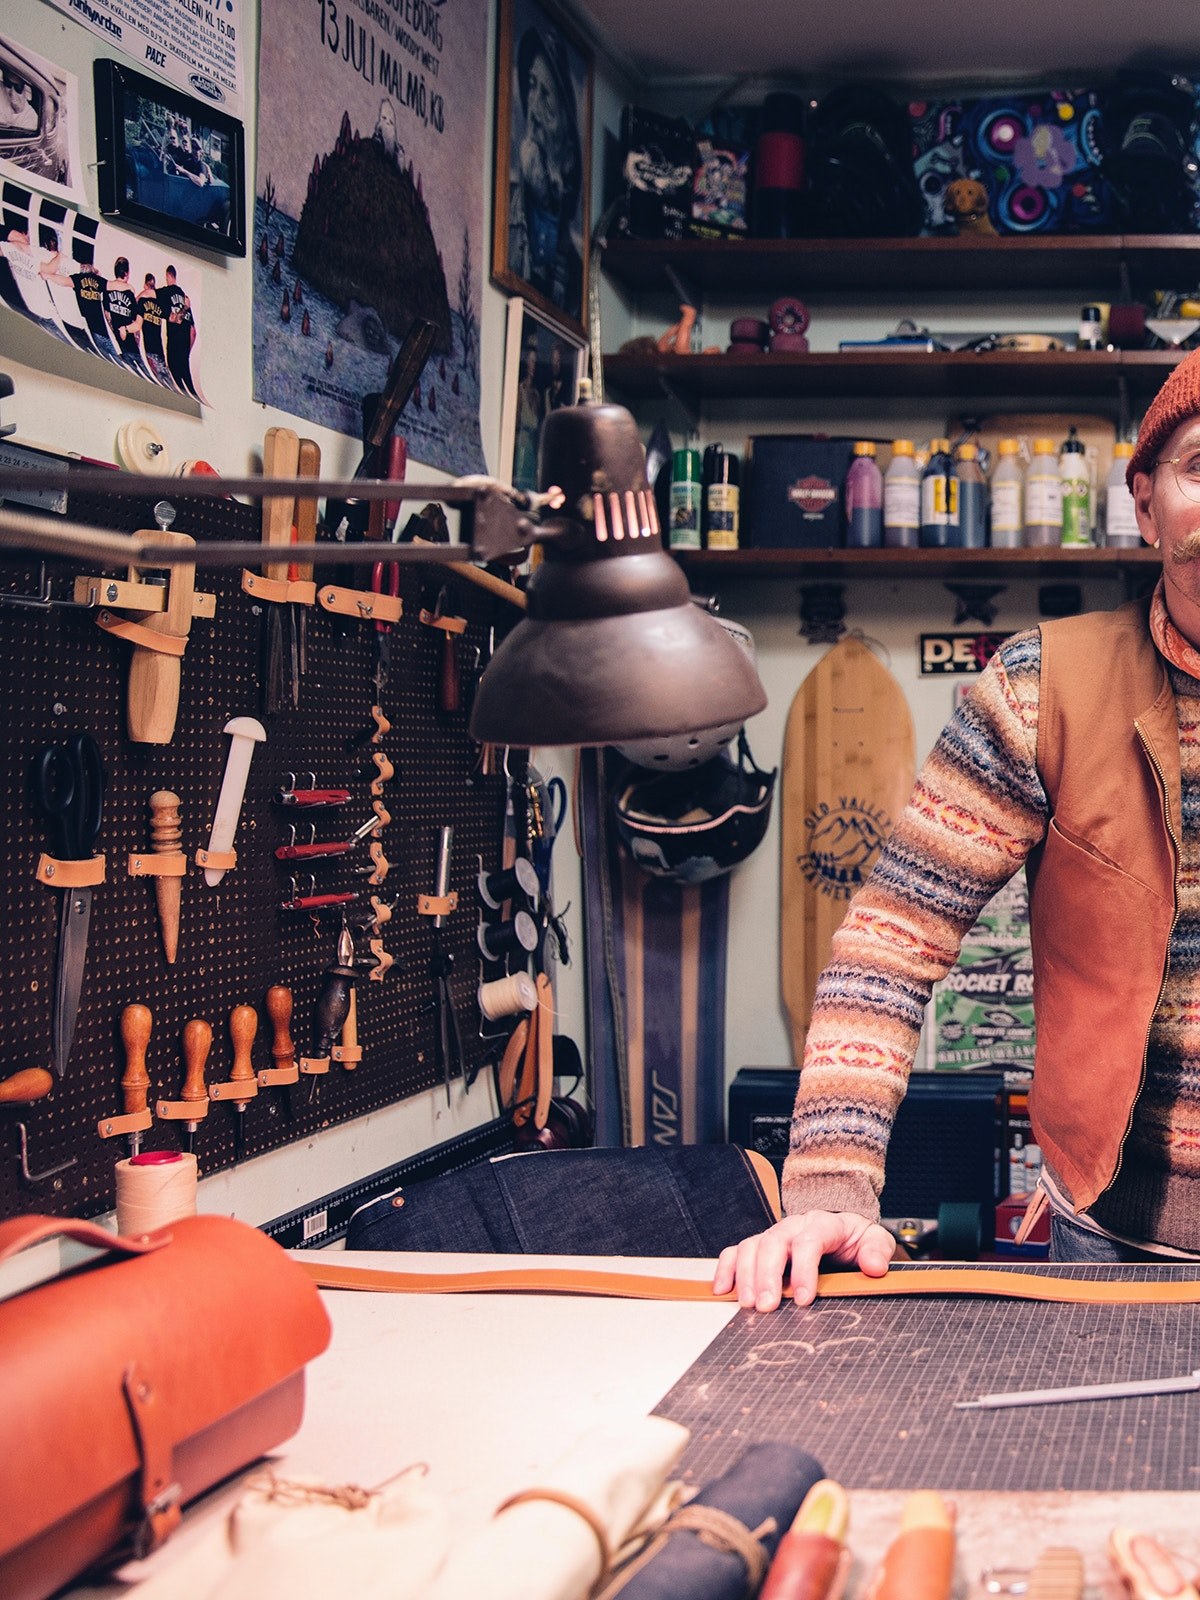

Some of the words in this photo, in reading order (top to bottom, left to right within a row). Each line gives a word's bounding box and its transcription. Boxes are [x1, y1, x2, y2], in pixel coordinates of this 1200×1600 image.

[110, 2, 136, 25] KVÄLLEN
[137, 20, 148, 34] MED
[169, 41, 196, 66] SKATEFILM
[205, 8, 214, 27] KL
[216, 16, 234, 41] 15.00
[145, 44, 167, 68] PACE
[318, 0, 339, 54] 13
[341, 14, 375, 87] JULI
[379, 48, 429, 129] MALMÖ,
[804, 802, 829, 830] OLD
[839, 796, 893, 828] VALLEY
[797, 852, 853, 900] LEATHER
